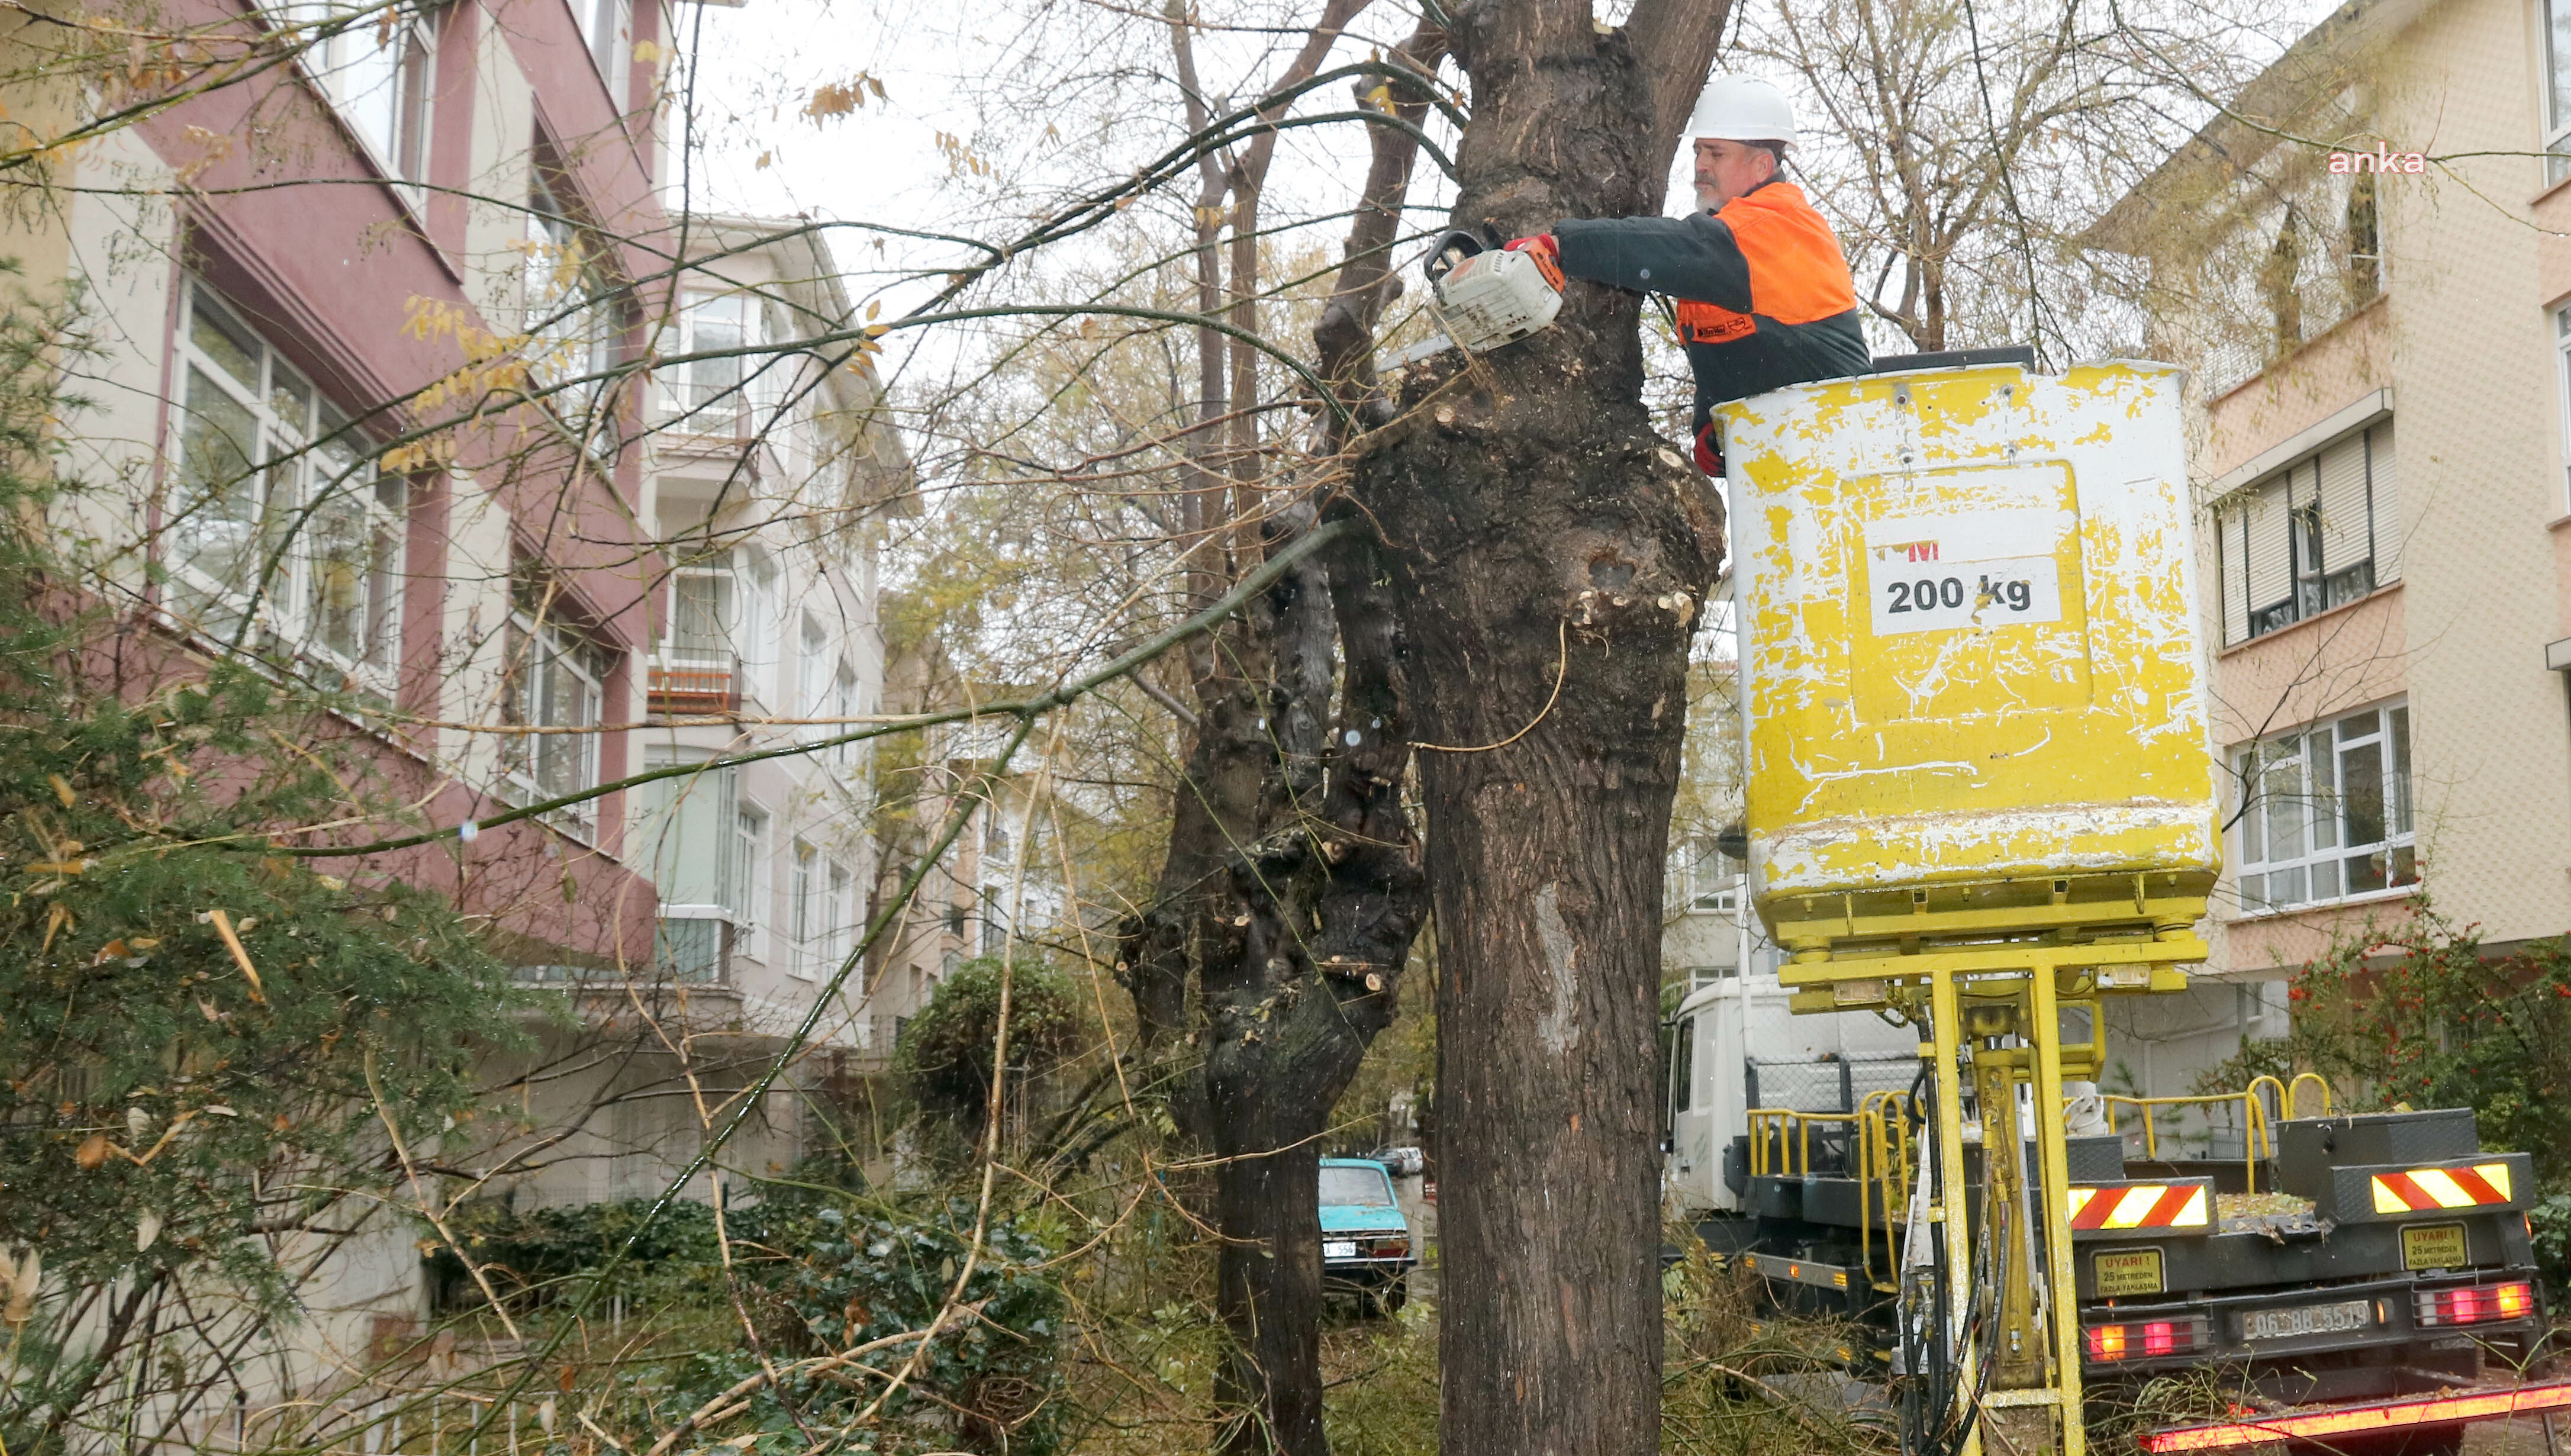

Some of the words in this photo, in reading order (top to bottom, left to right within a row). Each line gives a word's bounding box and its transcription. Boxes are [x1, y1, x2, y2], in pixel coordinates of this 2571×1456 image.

[1887, 577, 1964, 614] 200
[1979, 575, 2031, 611] kg
[2413, 1230, 2447, 1242] UYARI
[2411, 1245, 2422, 1255] 25
[2424, 1245, 2458, 1254] METREDEN
[2105, 1255, 2143, 1268] UYARI
[2408, 1258, 2428, 1266] FAZLA
[2103, 1271, 2115, 1282] 25
[2116, 1272, 2153, 1281] METREDEN
[2256, 1312, 2279, 1336] 06
